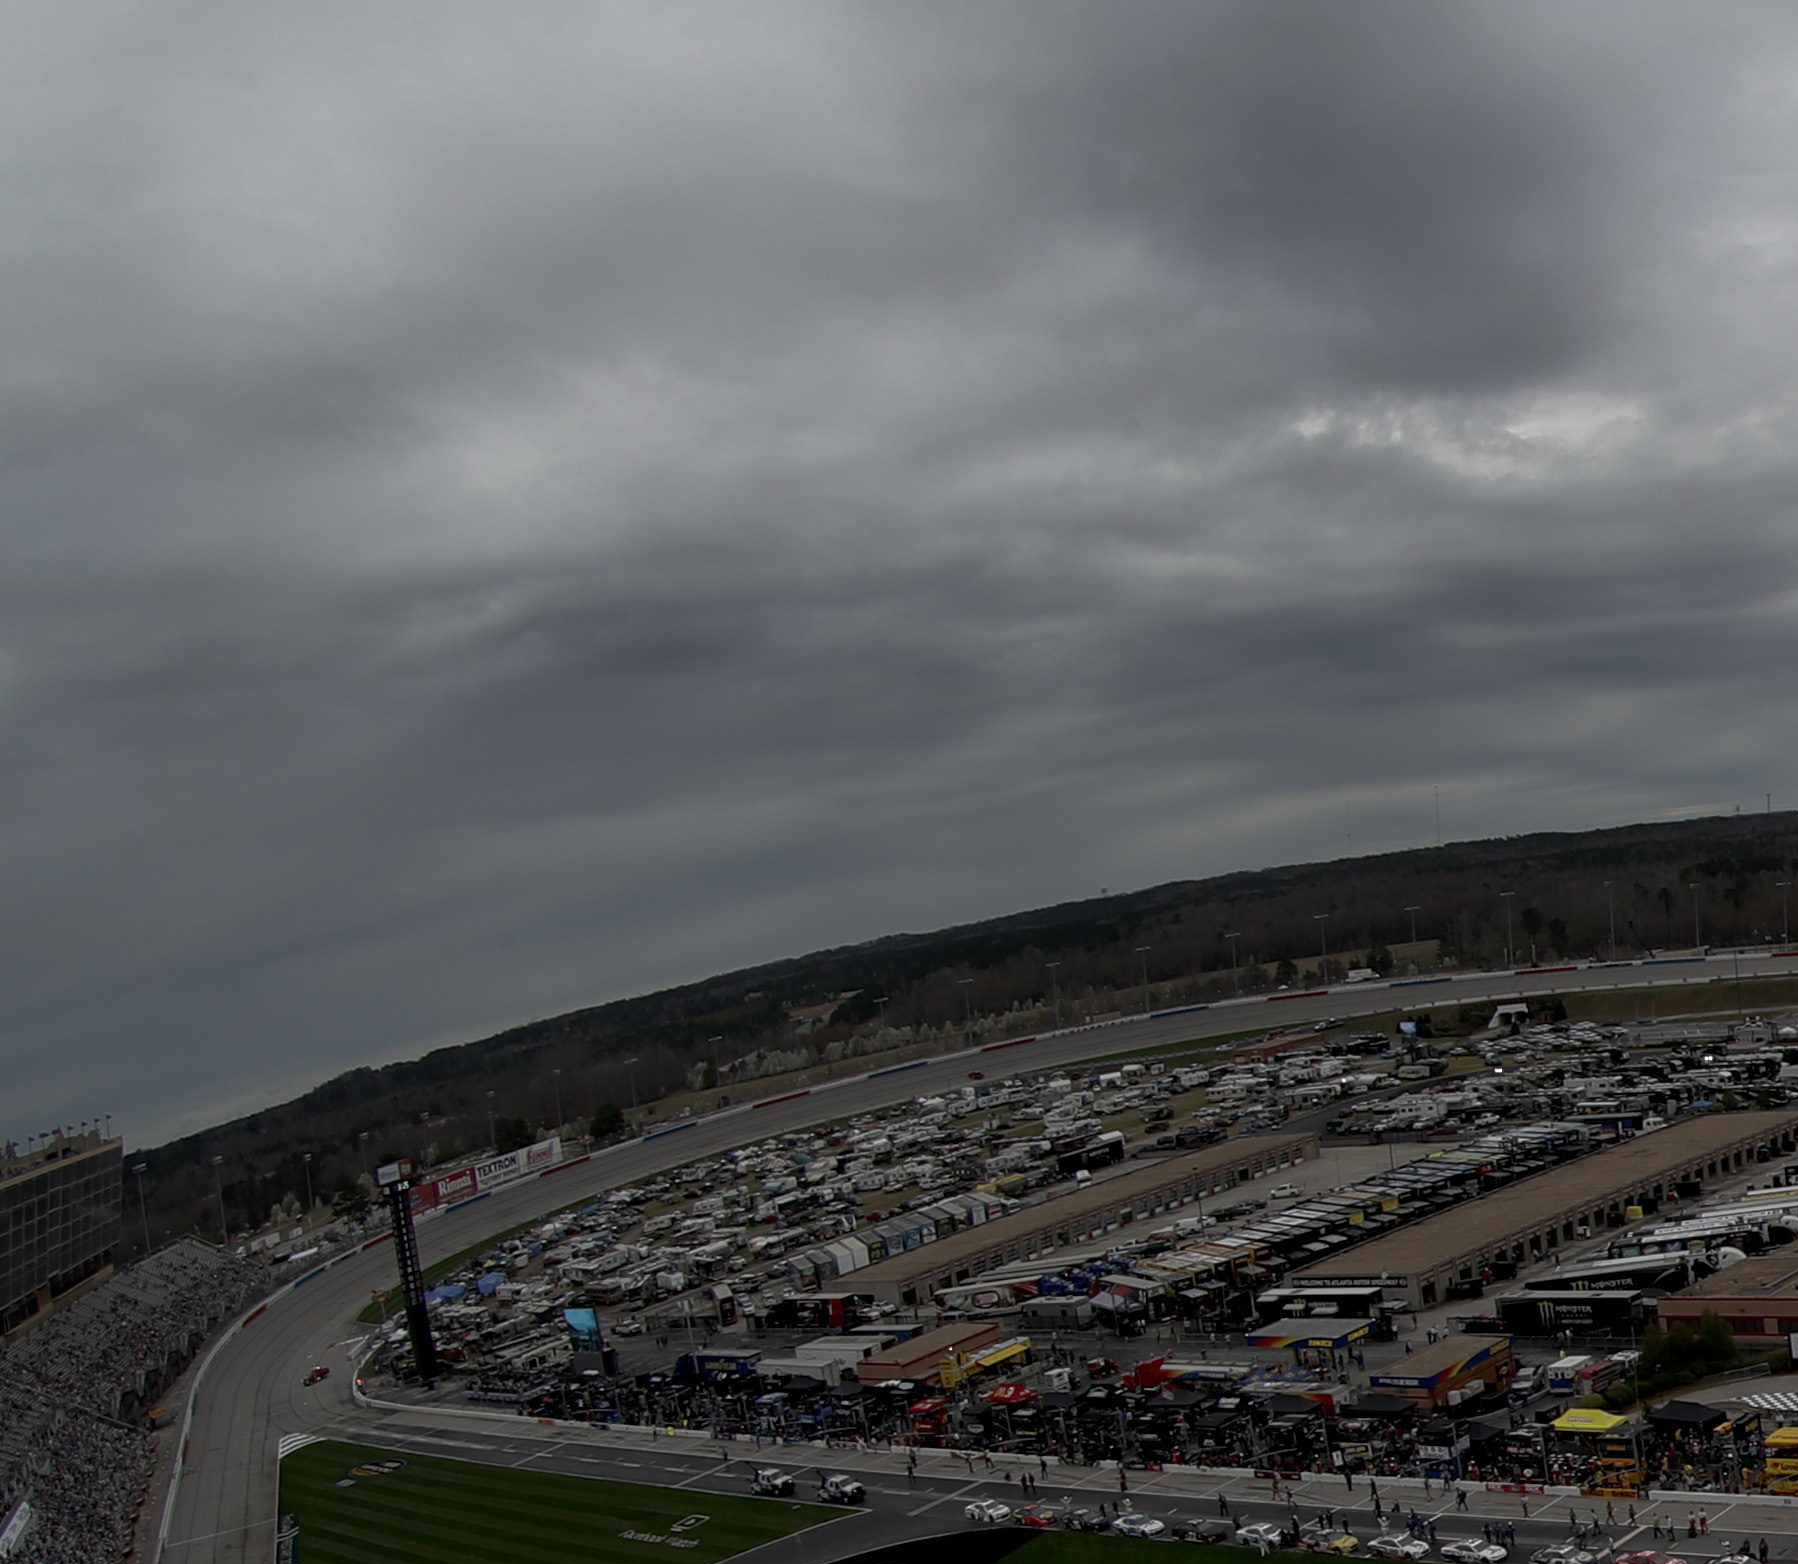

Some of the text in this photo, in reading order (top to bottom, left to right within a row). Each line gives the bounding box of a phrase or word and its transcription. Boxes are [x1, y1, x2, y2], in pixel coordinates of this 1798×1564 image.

[476, 1154, 517, 1179] TEXTRON
[437, 1170, 472, 1196] Rinnai
[1591, 1277, 1634, 1289] MONSTER
